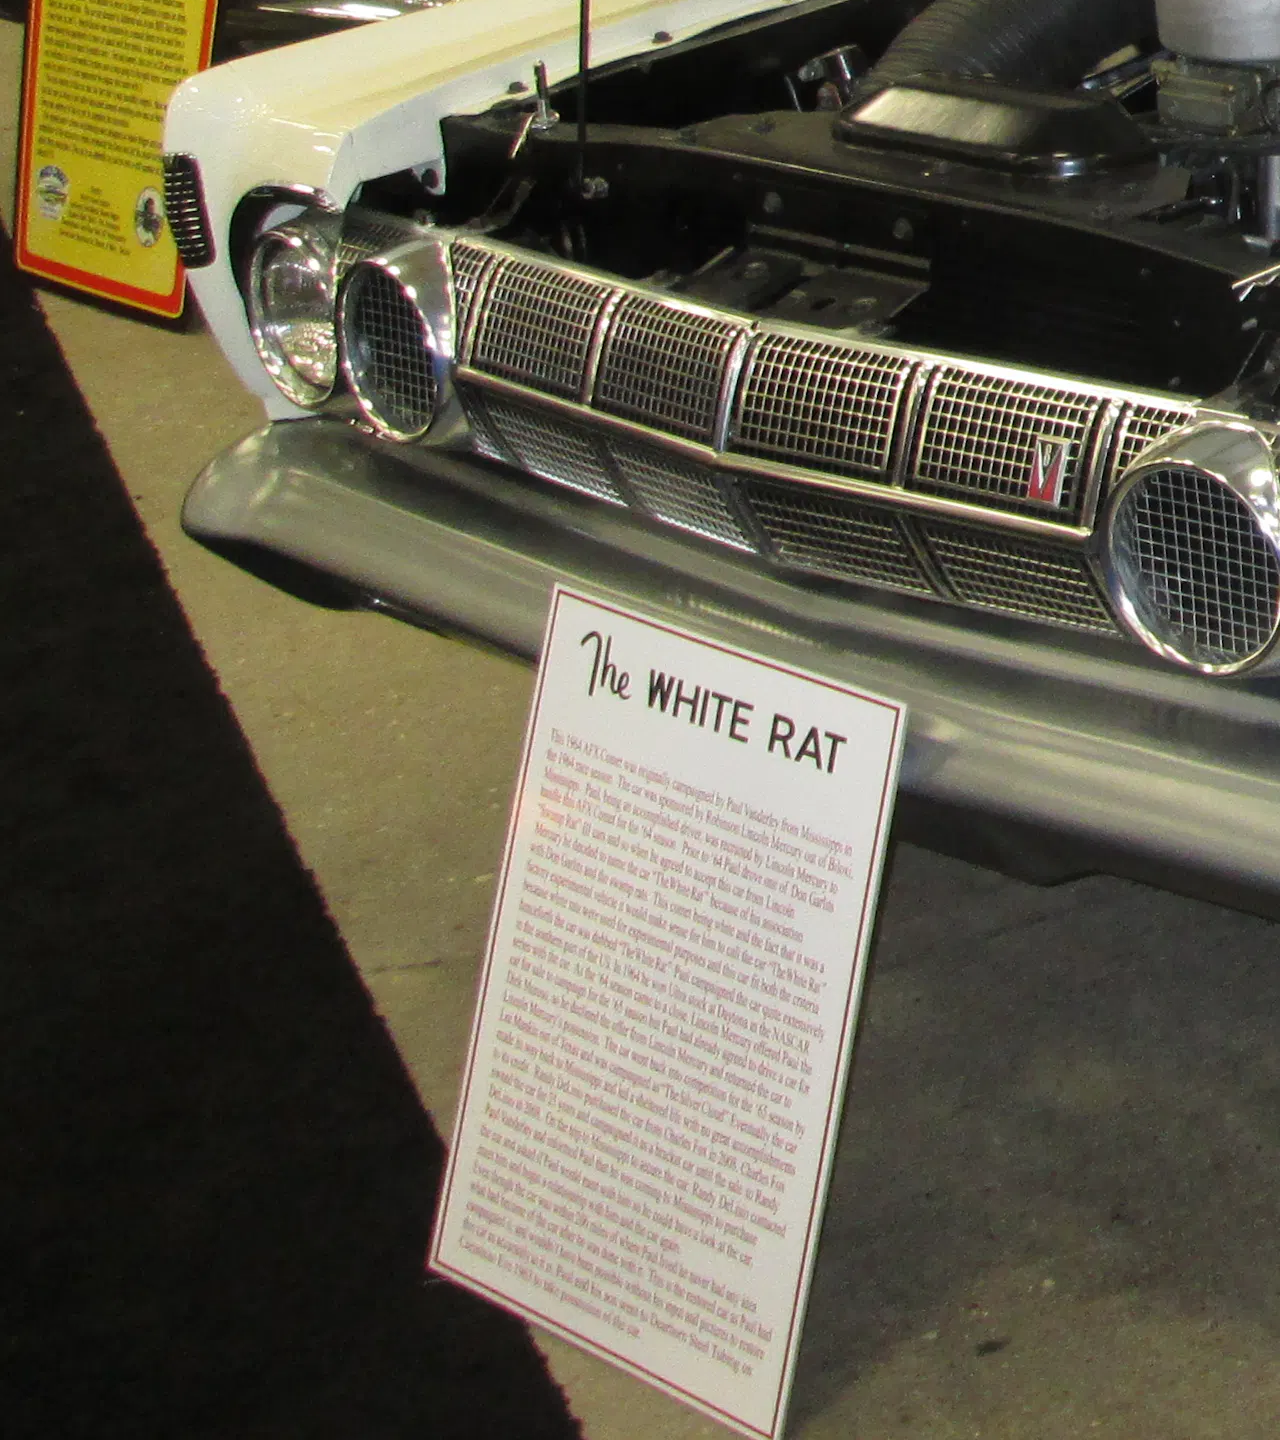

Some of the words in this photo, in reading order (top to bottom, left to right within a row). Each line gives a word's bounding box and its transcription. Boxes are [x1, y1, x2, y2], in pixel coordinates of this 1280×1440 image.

[580, 630, 632, 699] The
[647, 668, 754, 743] WHITE
[768, 713, 848, 775] RAT
